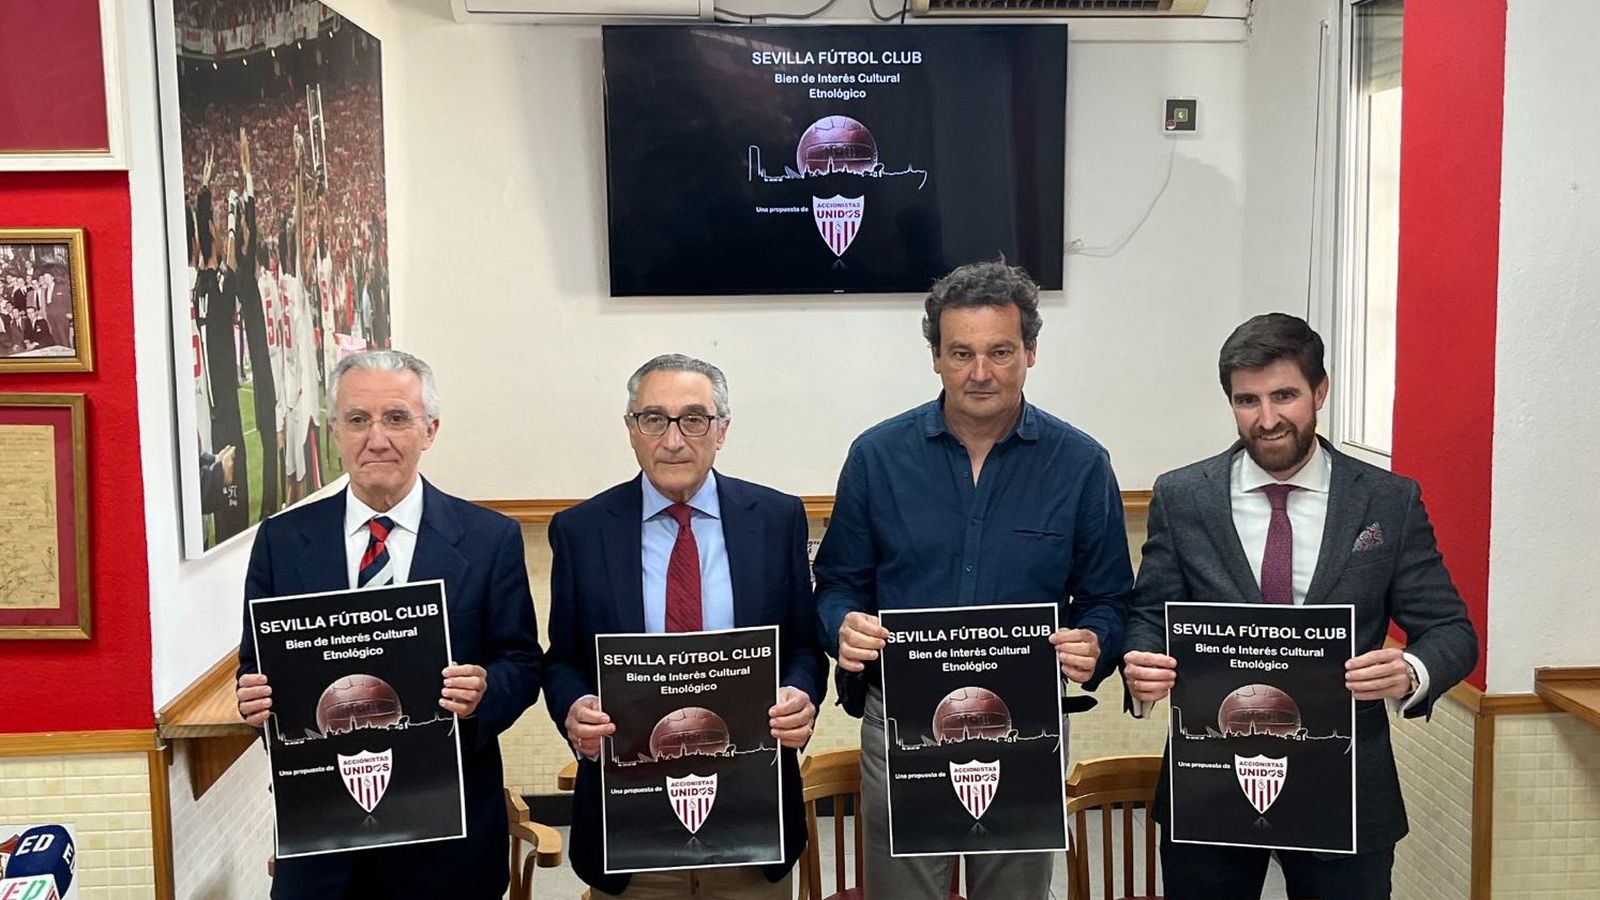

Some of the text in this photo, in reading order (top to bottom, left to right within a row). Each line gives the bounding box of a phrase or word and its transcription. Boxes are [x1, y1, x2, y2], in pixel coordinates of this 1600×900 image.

[752, 49, 922, 64] SEVILLA FÚTBOL CLUB
[775, 73, 900, 83] Bien de Interés Cultural
[809, 88, 866, 100] Etnológico
[260, 603, 439, 634] SEVILLA FÚTBOL CLUB
[286, 627, 418, 650] Bien de Interés Cultural
[887, 625, 1051, 643] SEVILLA FÚTBOL CLUB
[1173, 624, 1346, 640] SEVILLA FÚTBOL CLUB
[324, 647, 384, 660] Etnológico
[604, 646, 772, 665] SEVILLA FÚTBOL CLUB
[909, 646, 1030, 659] Bien de Interés Cultural
[1195, 644, 1324, 657] Bien de Interés Cultural
[943, 662, 998, 672] Etnológico
[1230, 659, 1288, 671] Etnológico
[626, 666, 750, 682] Bien de Interés Cultural
[661, 683, 717, 694] Etnológico
[343, 756, 388, 765] ACCIONISTAS
[294, 766, 325, 776] propuesta
[15, 834, 55, 856] ED
